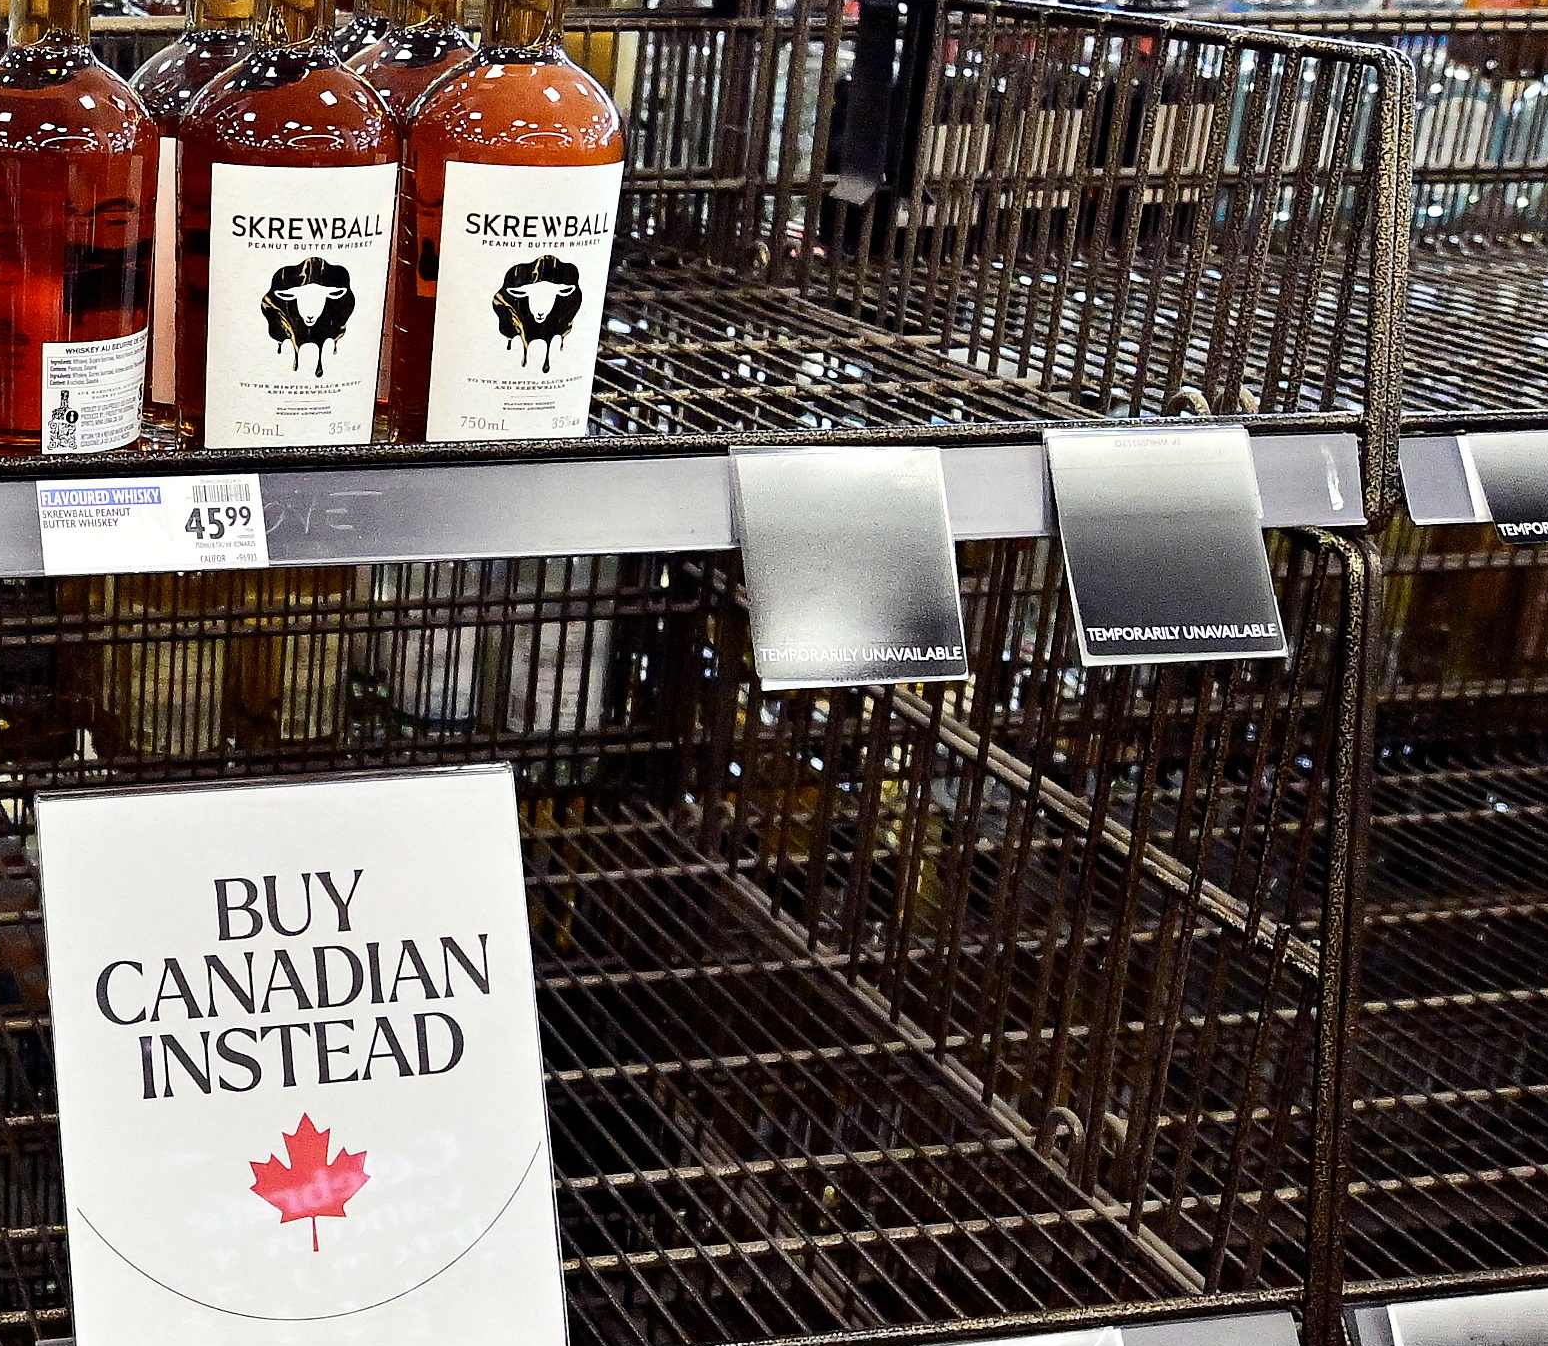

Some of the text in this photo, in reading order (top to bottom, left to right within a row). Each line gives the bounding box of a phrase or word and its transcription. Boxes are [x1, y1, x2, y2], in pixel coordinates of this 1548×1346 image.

[231, 213, 383, 240] SKREWBALL
[466, 211, 609, 239] SKREWBALL
[247, 240, 374, 251] PEANUT BUTTER WHISKEY
[481, 238, 602, 249] PEANUT BUTTER WHISKEY
[235, 421, 284, 437] 750mL
[460, 416, 510, 432] 750mL
[40, 488, 160, 505] FLAVOURED WHISKY
[42, 508, 131, 519] SKREWBALL PEANUT
[43, 518, 119, 529] BUTTER WHISKEY
[1087, 623, 1276, 643] TEMPORARILY UNAVAILABLE
[760, 646, 962, 662] TEMPORARILY UNAVAILABLE
[214, 869, 363, 941] BUY
[96, 934, 491, 1025] CANADIAN
[139, 1012, 464, 1100] INSTEAD
